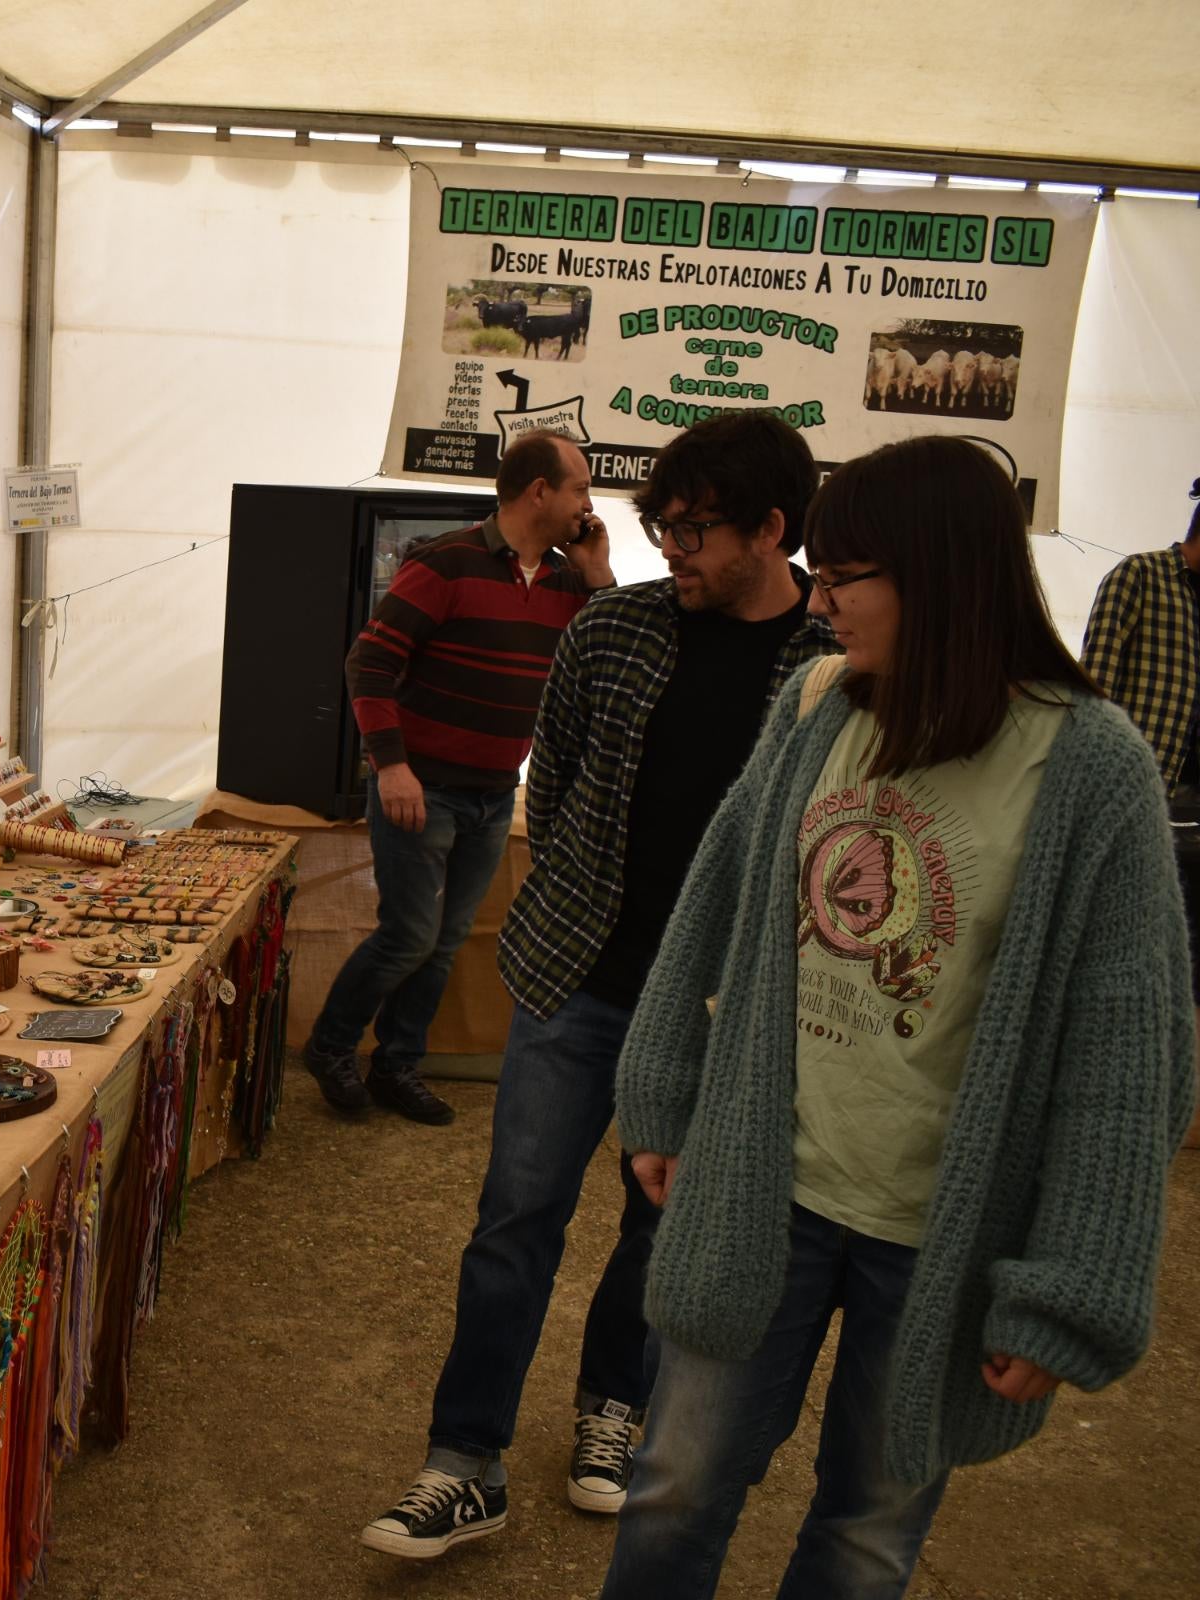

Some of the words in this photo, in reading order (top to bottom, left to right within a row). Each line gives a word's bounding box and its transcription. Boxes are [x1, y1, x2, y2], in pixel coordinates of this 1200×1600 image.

[448, 195, 609, 235] TERNERA
[630, 206, 693, 239] DEL
[715, 211, 810, 245] BAJO
[832, 217, 978, 254] TORMES
[1000, 225, 1041, 258] SL
[815, 262, 832, 294] A
[619, 308, 659, 339] DE
[665, 304, 839, 353] PRODUCTOR
[685, 338, 763, 358] carne
[455, 361, 484, 374] equipo
[704, 356, 738, 377] de
[449, 384, 481, 396] ofertas
[670, 374, 769, 400] ternera
[447, 396, 480, 408] precios
[609, 386, 632, 414] A
[445, 408, 479, 420] recetas
[508, 417, 535, 431] visita
[537, 411, 574, 427] nuestra
[440, 420, 478, 432] contacto
[434, 435, 477, 447] envasado
[415, 459, 422, 469] y
[423, 458, 453, 469] mucho
[9, 486, 29, 499] Ternera
[54, 484, 72, 496] Tormes
[919, 838, 957, 946] energy
